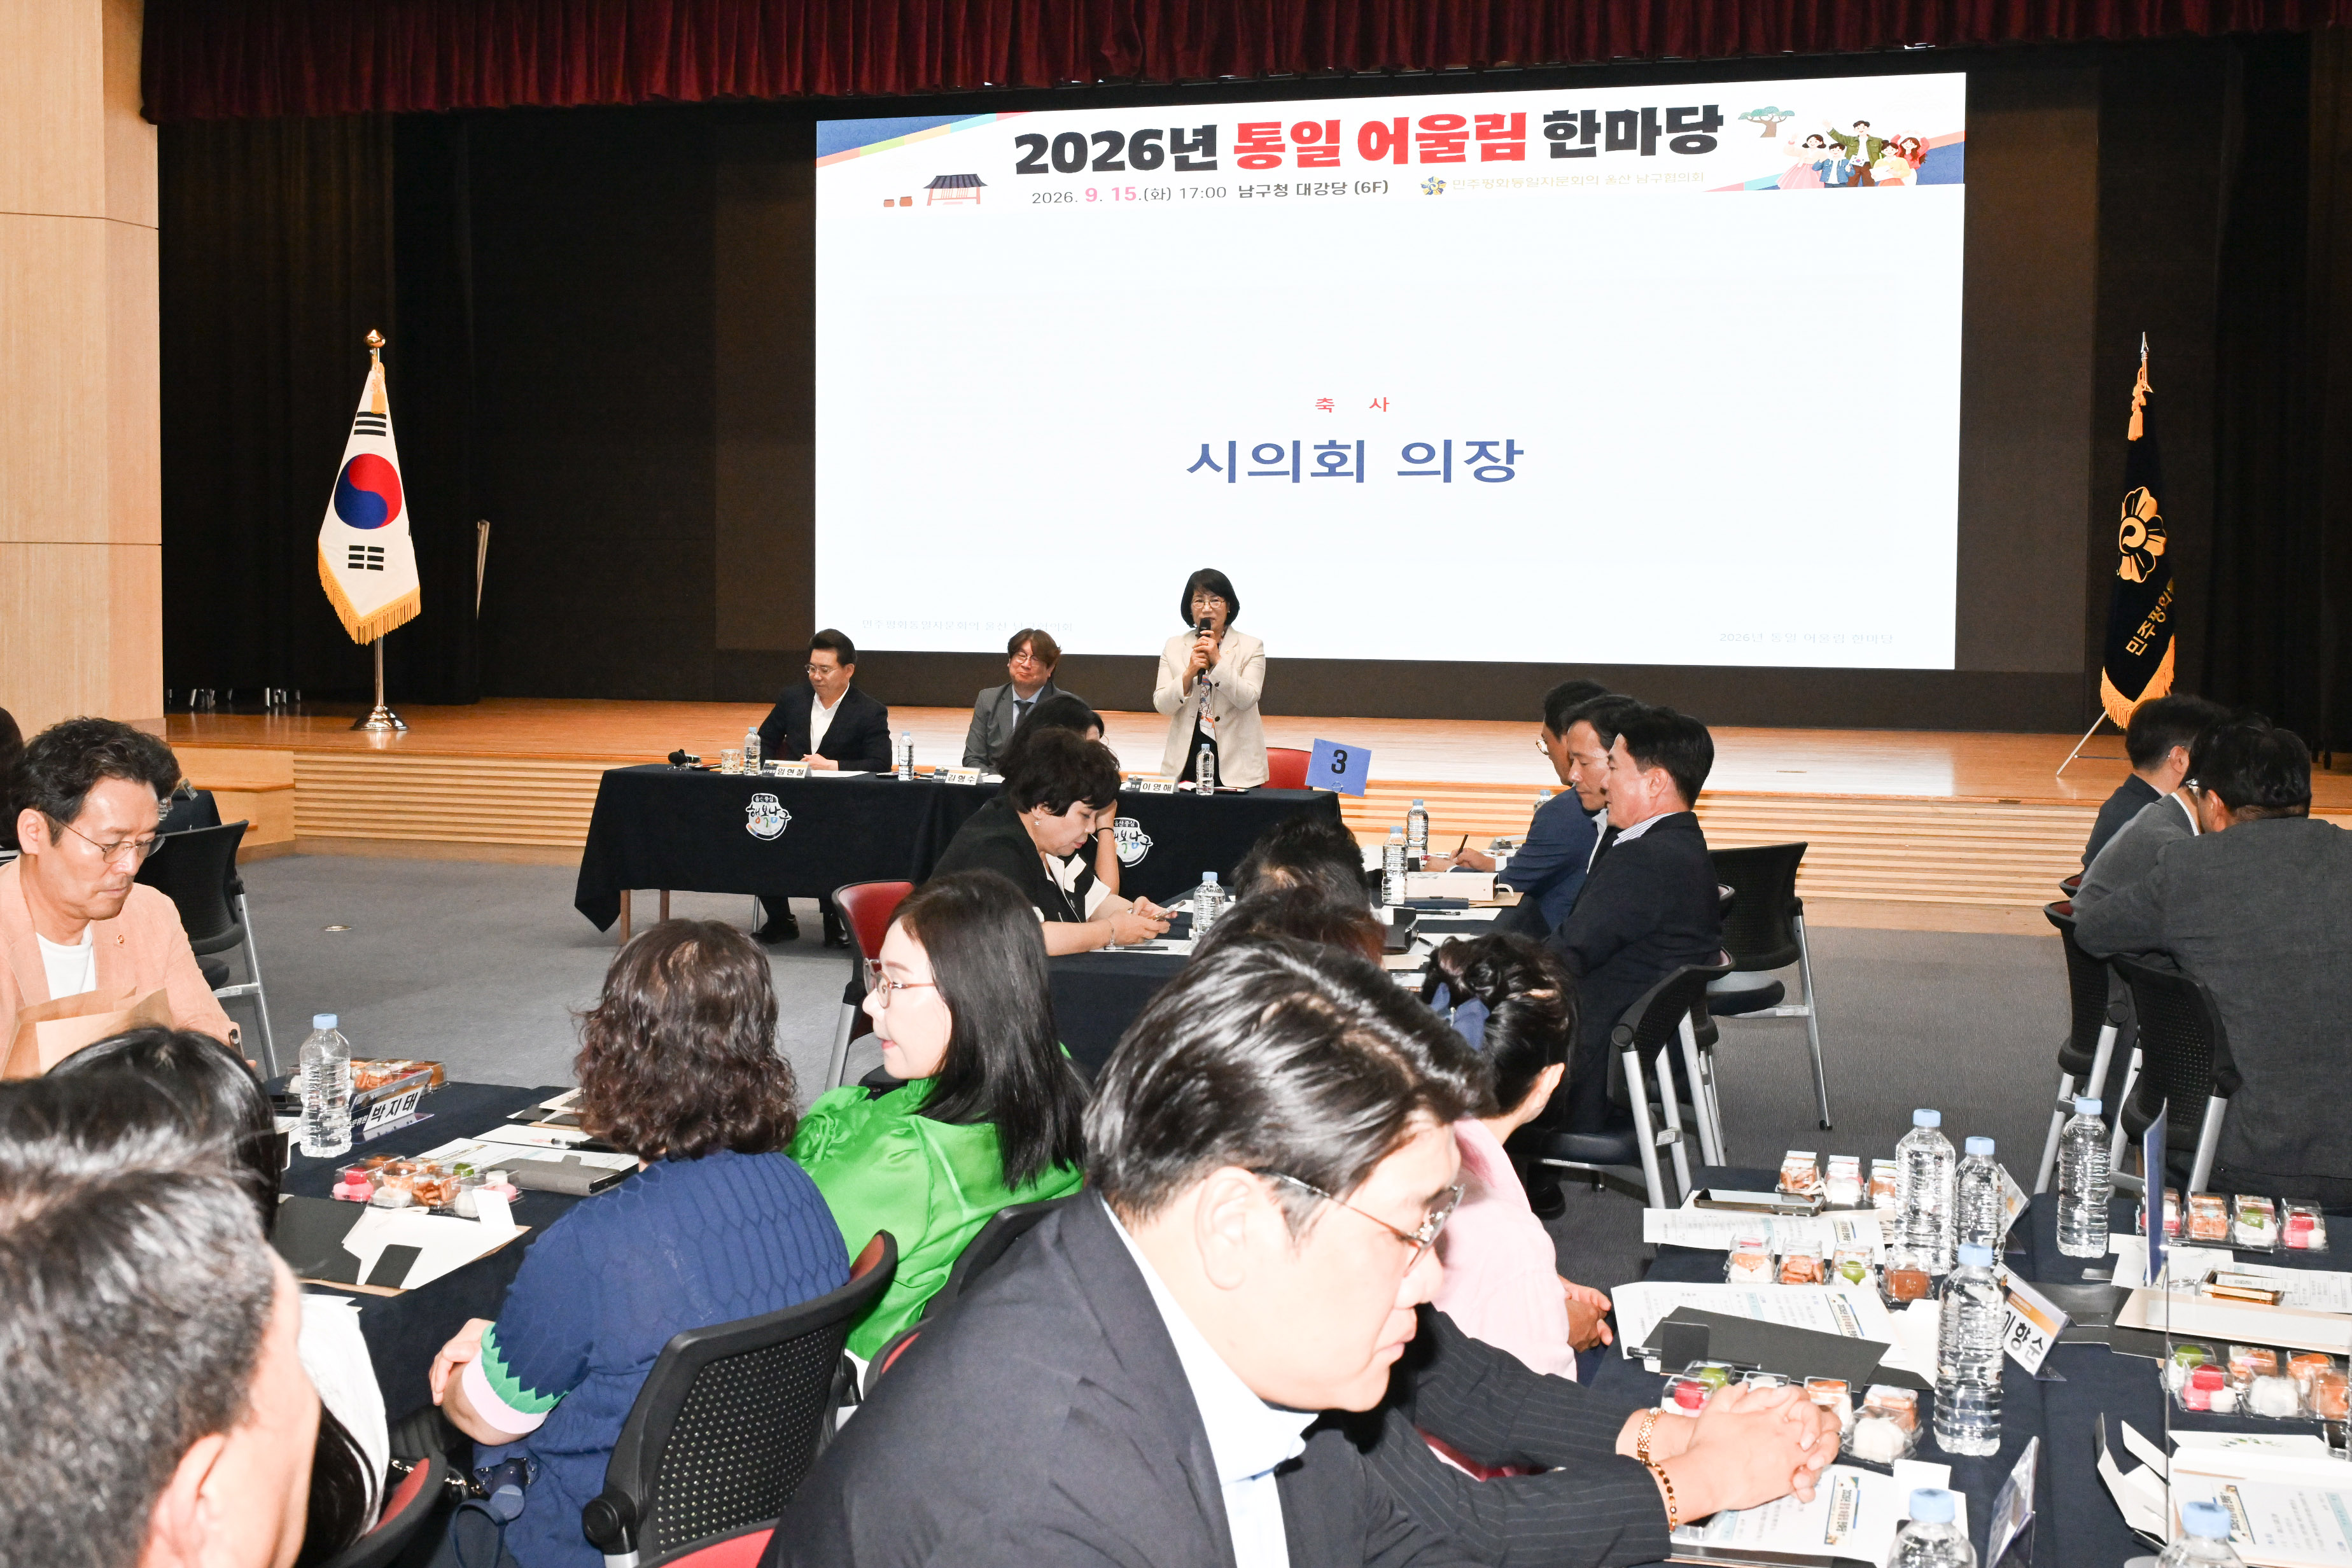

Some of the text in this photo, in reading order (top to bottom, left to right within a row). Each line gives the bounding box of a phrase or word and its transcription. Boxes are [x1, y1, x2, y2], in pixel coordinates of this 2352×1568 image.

[1014, 104, 1724, 175] 2026년 통일 어울림 한마당
[1032, 192, 1078, 204] 2026.
[1084, 188, 1103, 202] 9.
[1179, 186, 1227, 199] 17:00
[1238, 183, 1289, 199] 남구청
[1296, 181, 1348, 196] 대강당
[1354, 179, 1389, 195] (6F)
[1452, 171, 1704, 190] 민주평화통일자문회의 울산 남구협의회
[1315, 396, 1390, 413] 축 사
[1186, 438, 1524, 484] 시의회 의장
[1331, 749, 1348, 774] 3
[370, 1091, 419, 1123] 박지태
